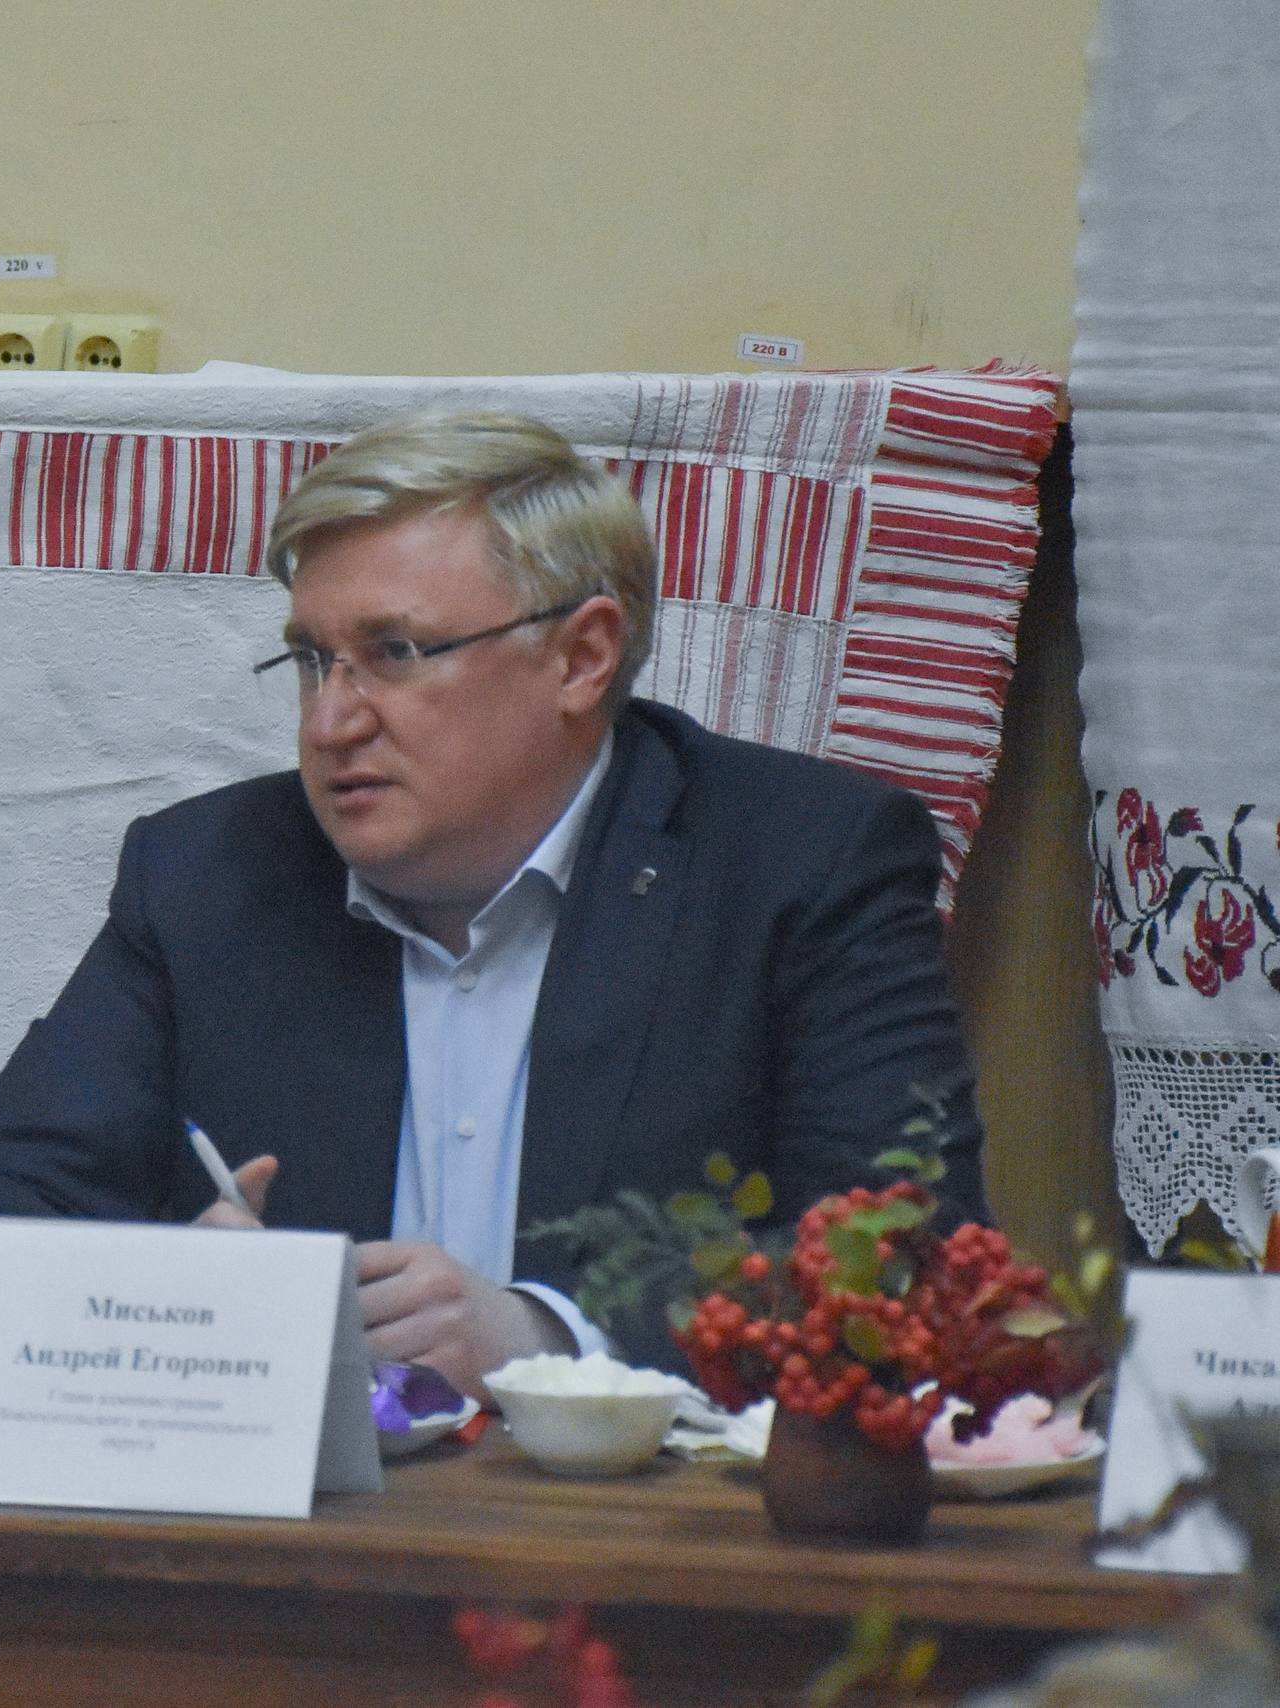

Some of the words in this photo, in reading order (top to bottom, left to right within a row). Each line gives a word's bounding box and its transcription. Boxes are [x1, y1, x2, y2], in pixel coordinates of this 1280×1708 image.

[5, 259, 29, 272] 220
[752, 343, 775, 355] 220
[86, 1296, 214, 1326] Миськов
[15, 1343, 121, 1374] Андрей
[132, 1346, 270, 1380] Егорович
